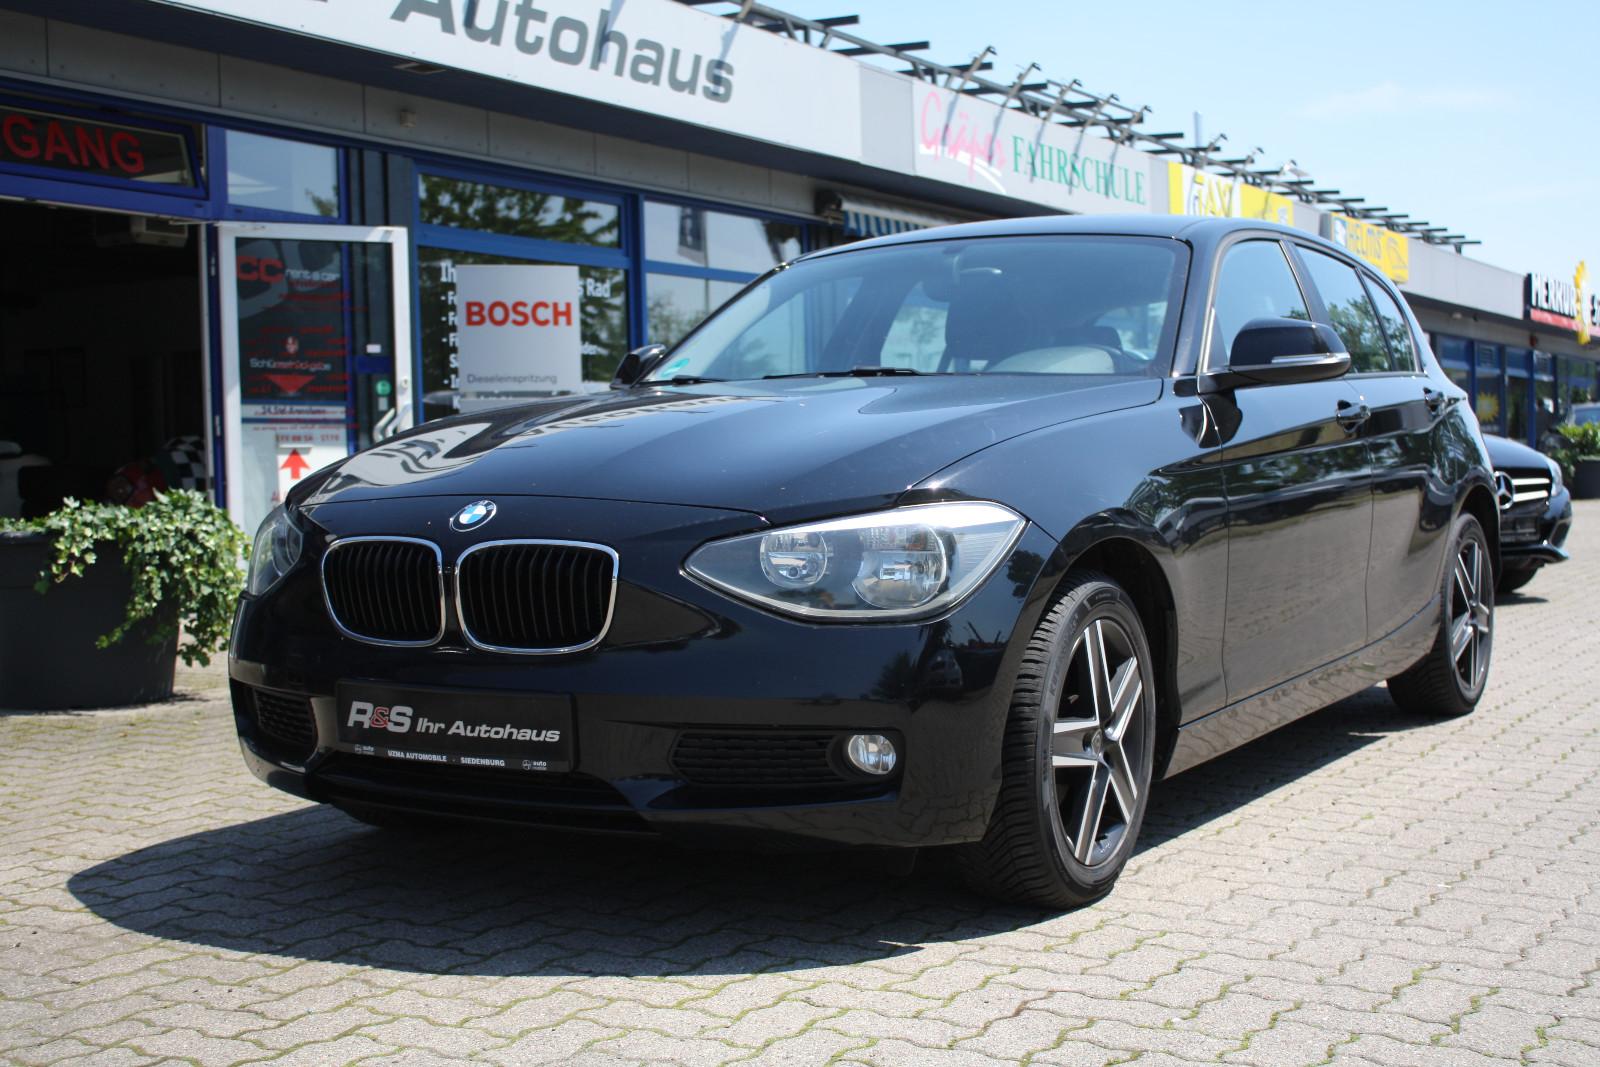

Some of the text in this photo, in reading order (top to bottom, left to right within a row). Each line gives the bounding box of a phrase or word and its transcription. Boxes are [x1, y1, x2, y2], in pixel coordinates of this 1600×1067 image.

[1011, 135, 1146, 205] FAHRSCHULE
[465, 300, 573, 327] BOSCH
[466, 373, 558, 385] Dieseleinspritzung
[347, 700, 561, 743] R&S Ihr Autohaus
[405, 752, 447, 762] AUTOMOBILE
[460, 756, 505, 767] SIEDENBURG
